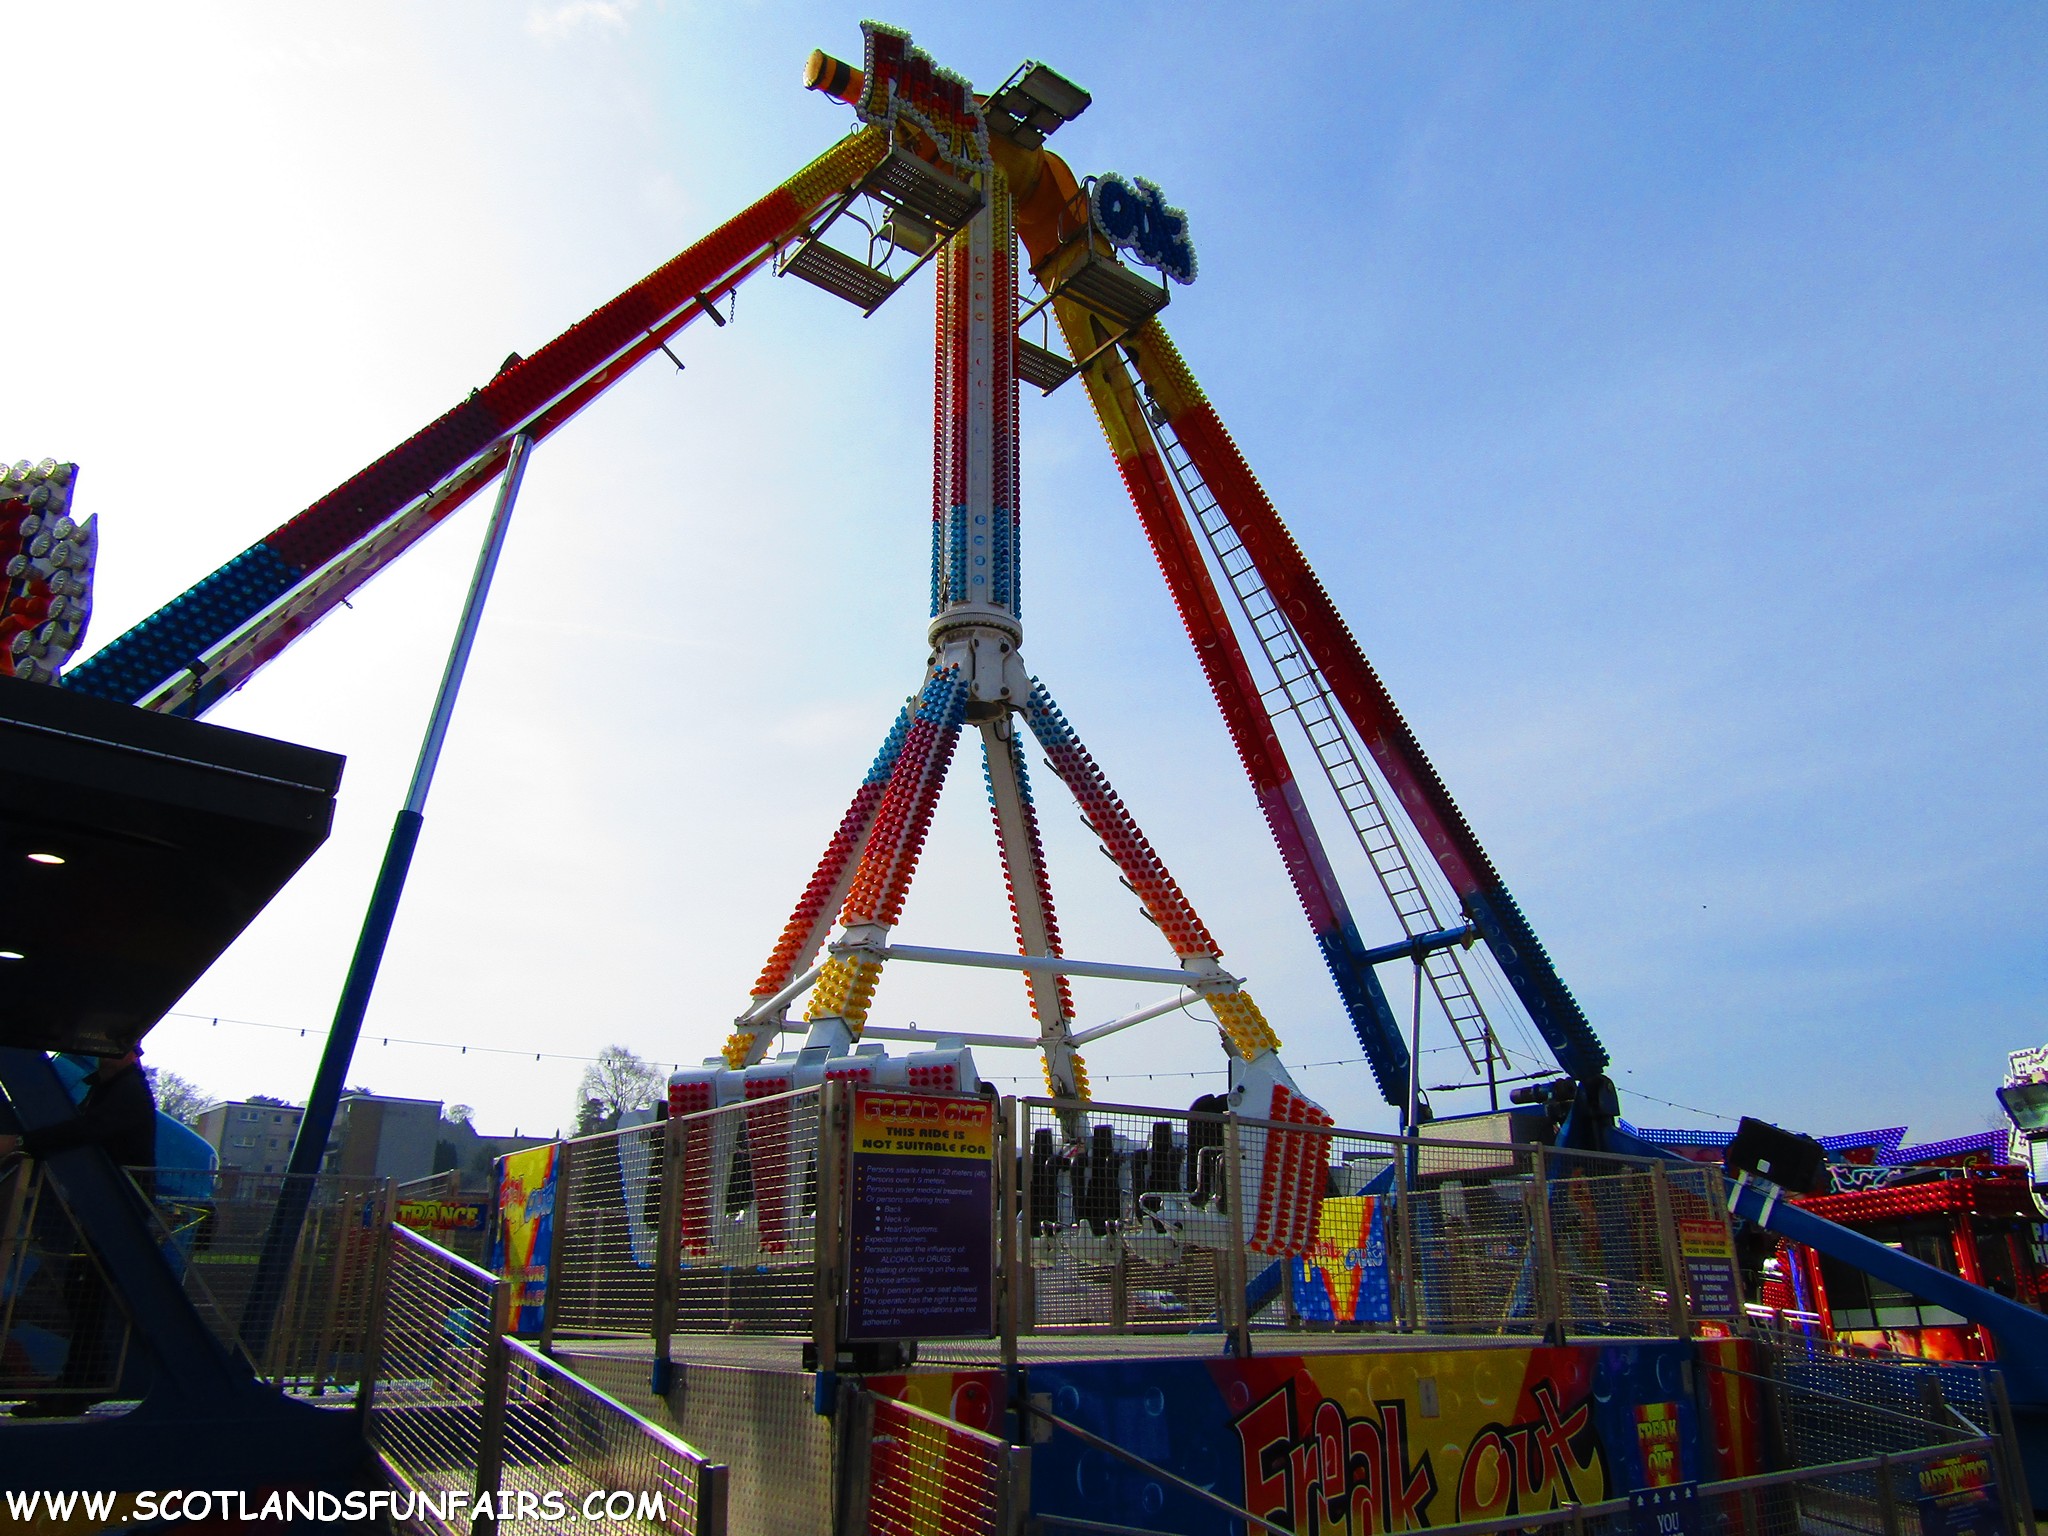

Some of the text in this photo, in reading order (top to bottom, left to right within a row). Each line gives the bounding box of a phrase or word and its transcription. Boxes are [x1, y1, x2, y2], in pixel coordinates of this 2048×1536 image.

[864, 1098, 987, 1127] FREAK OUT
[886, 1126, 965, 1140] THIS RIDE IS
[862, 1138, 986, 1155] NOT SUITABLE FOR
[866, 1165, 894, 1174] Persons
[895, 1166, 919, 1174] smaller
[921, 1167, 935, 1175] than
[951, 1169, 973, 1177] meters
[866, 1175, 894, 1184] Persons
[866, 1185, 894, 1193] Persons
[895, 1186, 914, 1194] under
[916, 1186, 942, 1194] medical
[876, 1196, 904, 1204] persons
[905, 1196, 933, 1204] suffering
[884, 1205, 901, 1213] Back
[400, 1204, 479, 1228] TRANCE
[884, 1215, 901, 1223] Neck
[865, 1235, 898, 1244] Expectant
[864, 1246, 892, 1254] Persons
[880, 1255, 915, 1264] ALCOHOL
[926, 1255, 951, 1263] DRUGS
[864, 1266, 874, 1274] No
[876, 1266, 897, 1275] eating
[907, 1266, 934, 1274] drinking
[863, 1276, 874, 1284] No
[876, 1276, 895, 1284] loose
[863, 1286, 880, 1295] Only
[887, 1287, 911, 1295] person
[912, 1287, 924, 1295] per
[863, 1297, 877, 1305] The
[934, 1296, 949, 1304] right
[916, 1306, 953, 1315] regulations
[862, 1319, 892, 1327] adhered
[1637, 1419, 1678, 1440] FREAK
[1647, 1450, 1675, 1473] OUT
[1656, 1511, 1679, 1533] YOU
